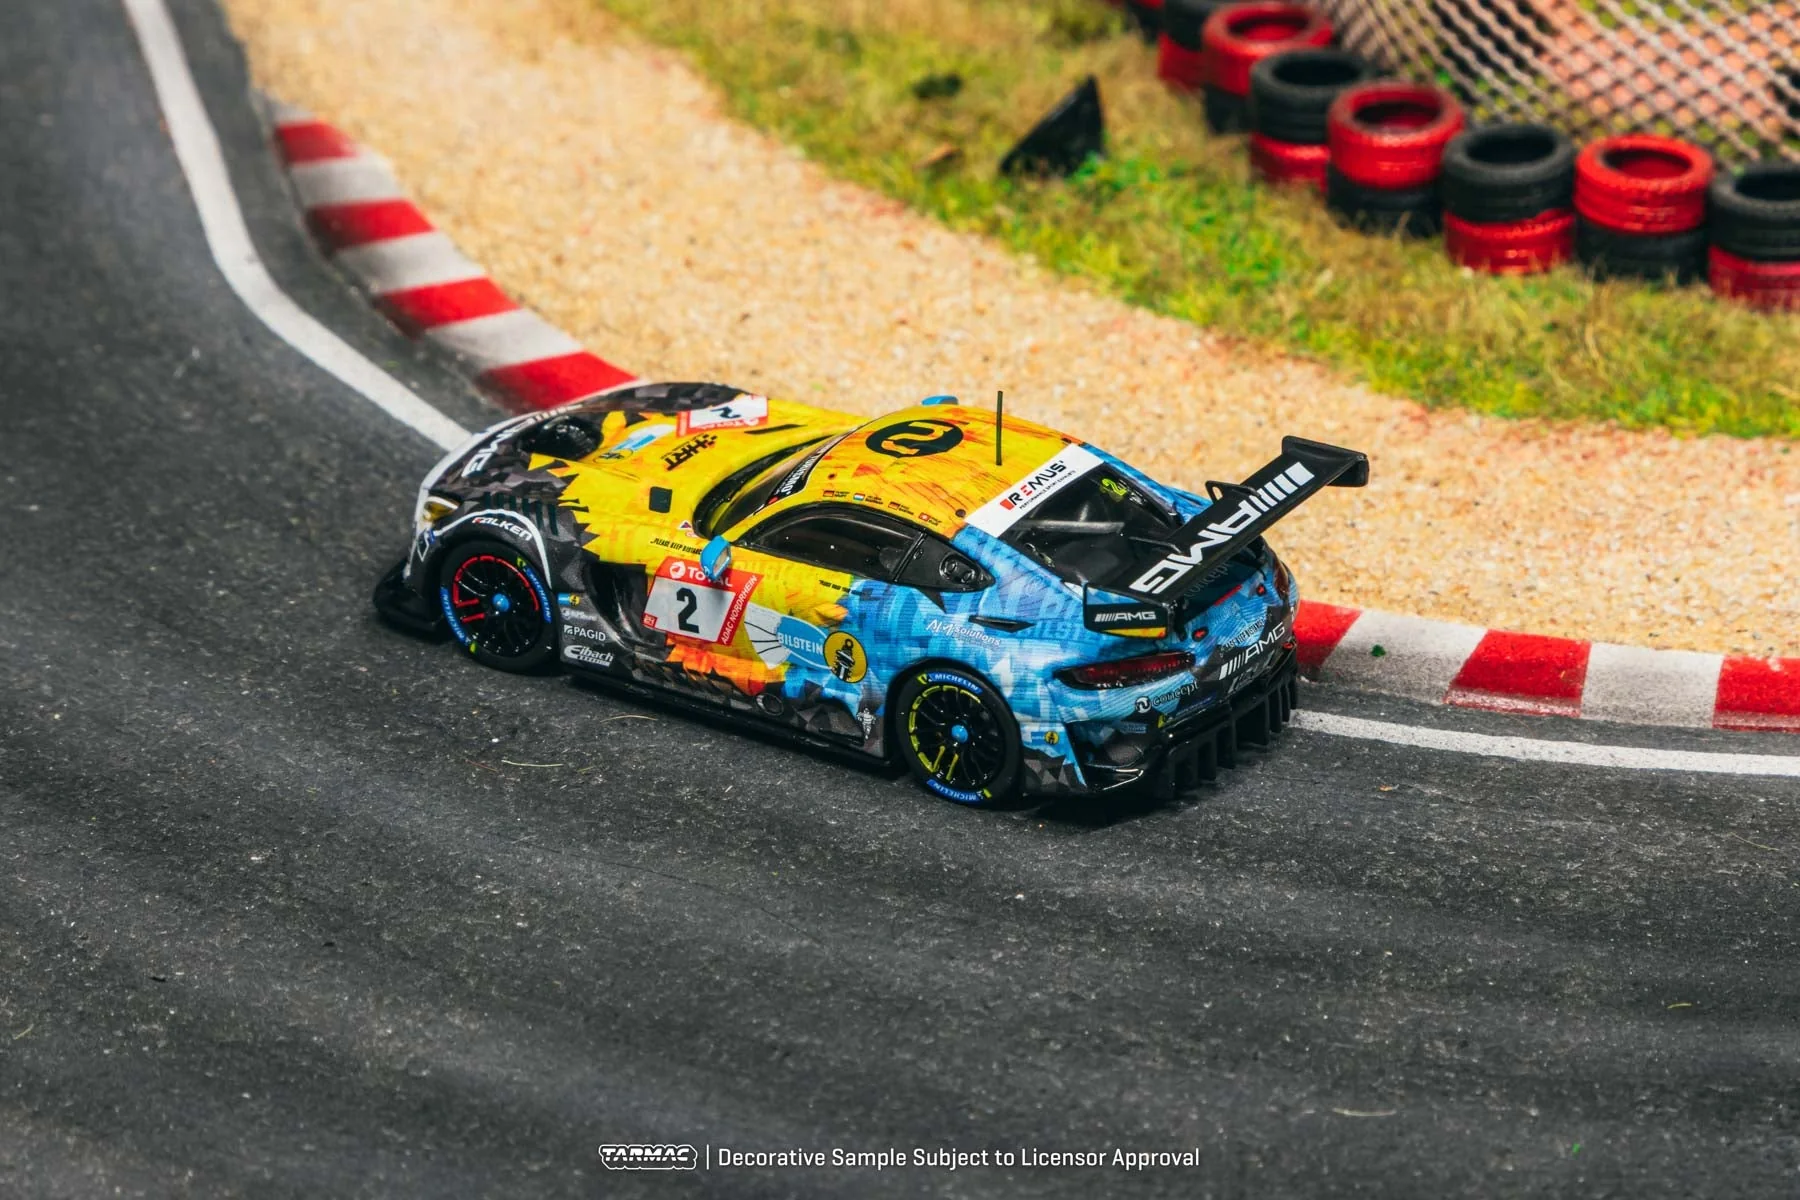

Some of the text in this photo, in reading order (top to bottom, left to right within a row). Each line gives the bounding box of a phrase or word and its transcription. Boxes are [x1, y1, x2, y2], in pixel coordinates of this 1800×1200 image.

[1009, 463, 1067, 506] REMUS
[472, 516, 533, 541] FALKEN
[1129, 500, 1263, 595] AMG
[676, 587, 700, 634] 2
[721, 575, 758, 645] ADAC NORDRHEIN
[1113, 611, 1157, 621] AMG
[574, 626, 606, 642] PAGID
[777, 633, 823, 655] BILSTEIN
[1245, 622, 1286, 665] AMG
[564, 645, 614, 662] Eibach
[935, 673, 979, 692] MICHELIN
[1152, 680, 1200, 706] concept
